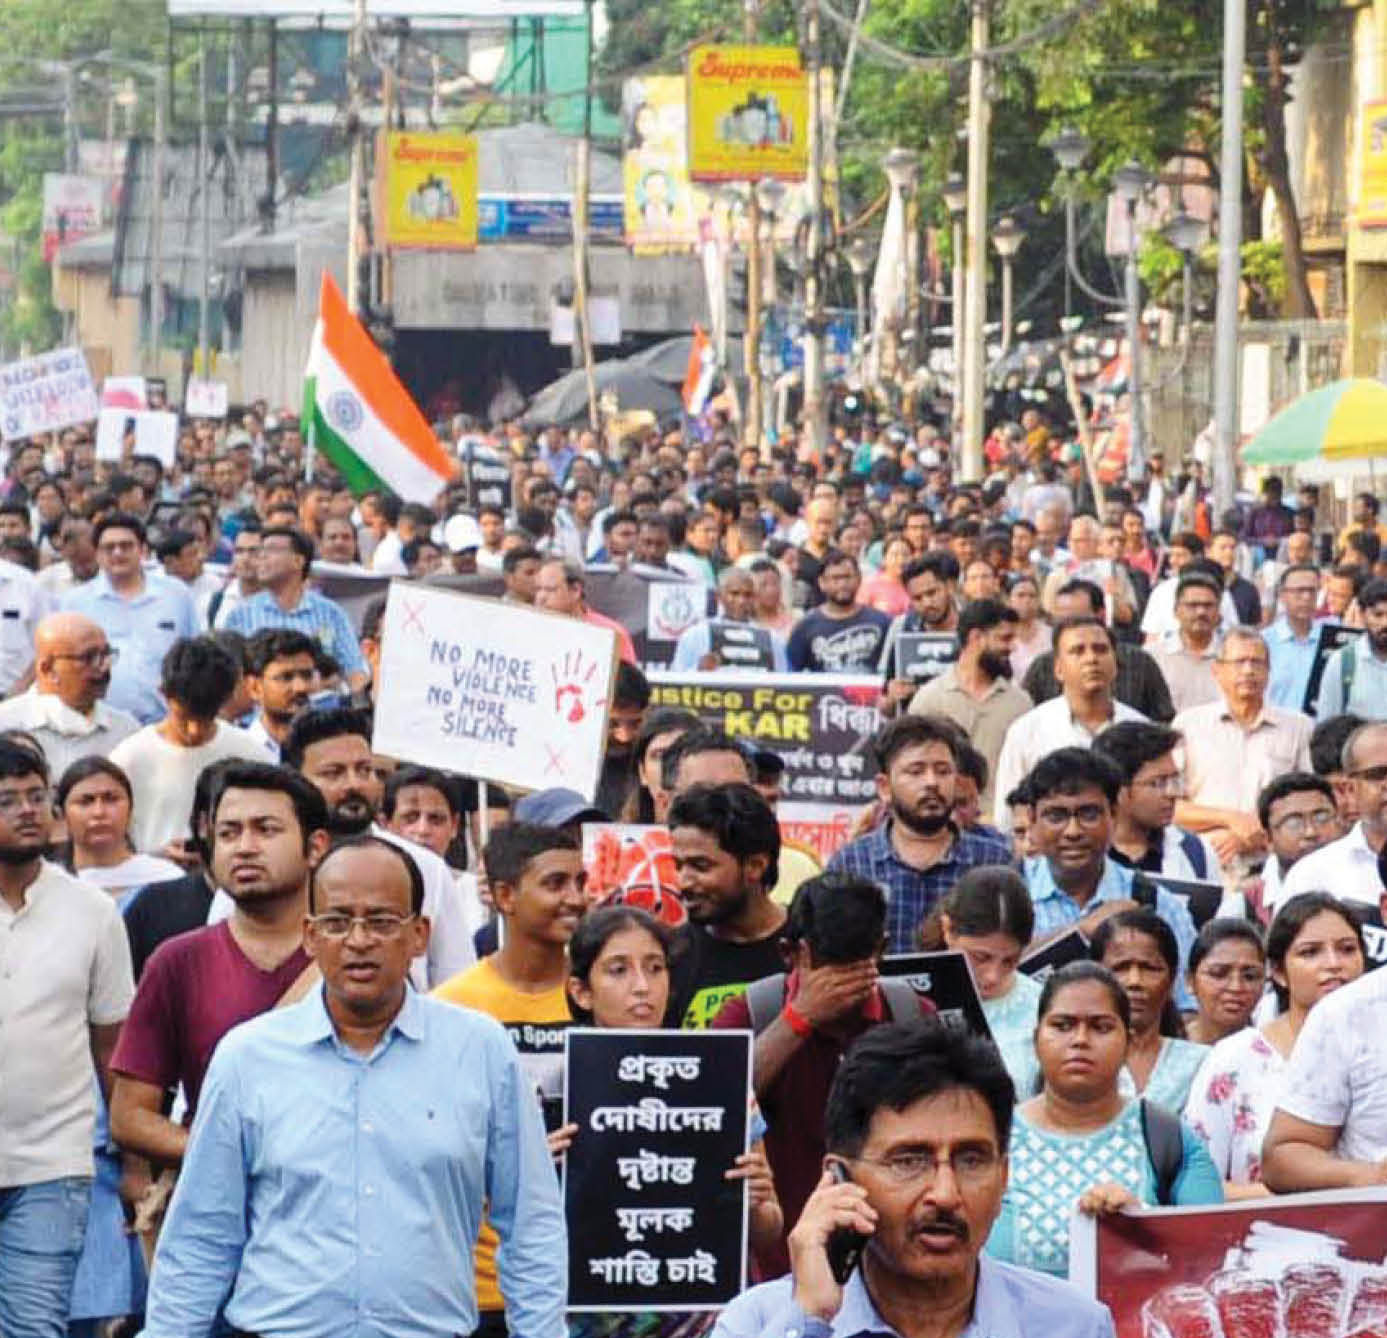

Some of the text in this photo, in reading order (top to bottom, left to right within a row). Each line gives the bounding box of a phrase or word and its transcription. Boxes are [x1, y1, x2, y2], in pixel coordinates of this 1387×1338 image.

[430, 640, 532, 682] NO MORE
[427, 685, 506, 720] NO MORE
[452, 668, 537, 704] VIOLENCE
[753, 687, 813, 712] For
[440, 712, 518, 748] SILENCE
[724, 711, 811, 740] KAR
[617, 1054, 701, 1089] প্রকৃত
[589, 1097, 725, 1132] দোষীদের
[616, 1149, 695, 1190] দৃষ্টান্ত
[615, 1207, 694, 1242] মূলক
[588, 1249, 717, 1286] শাস্তি চাই
